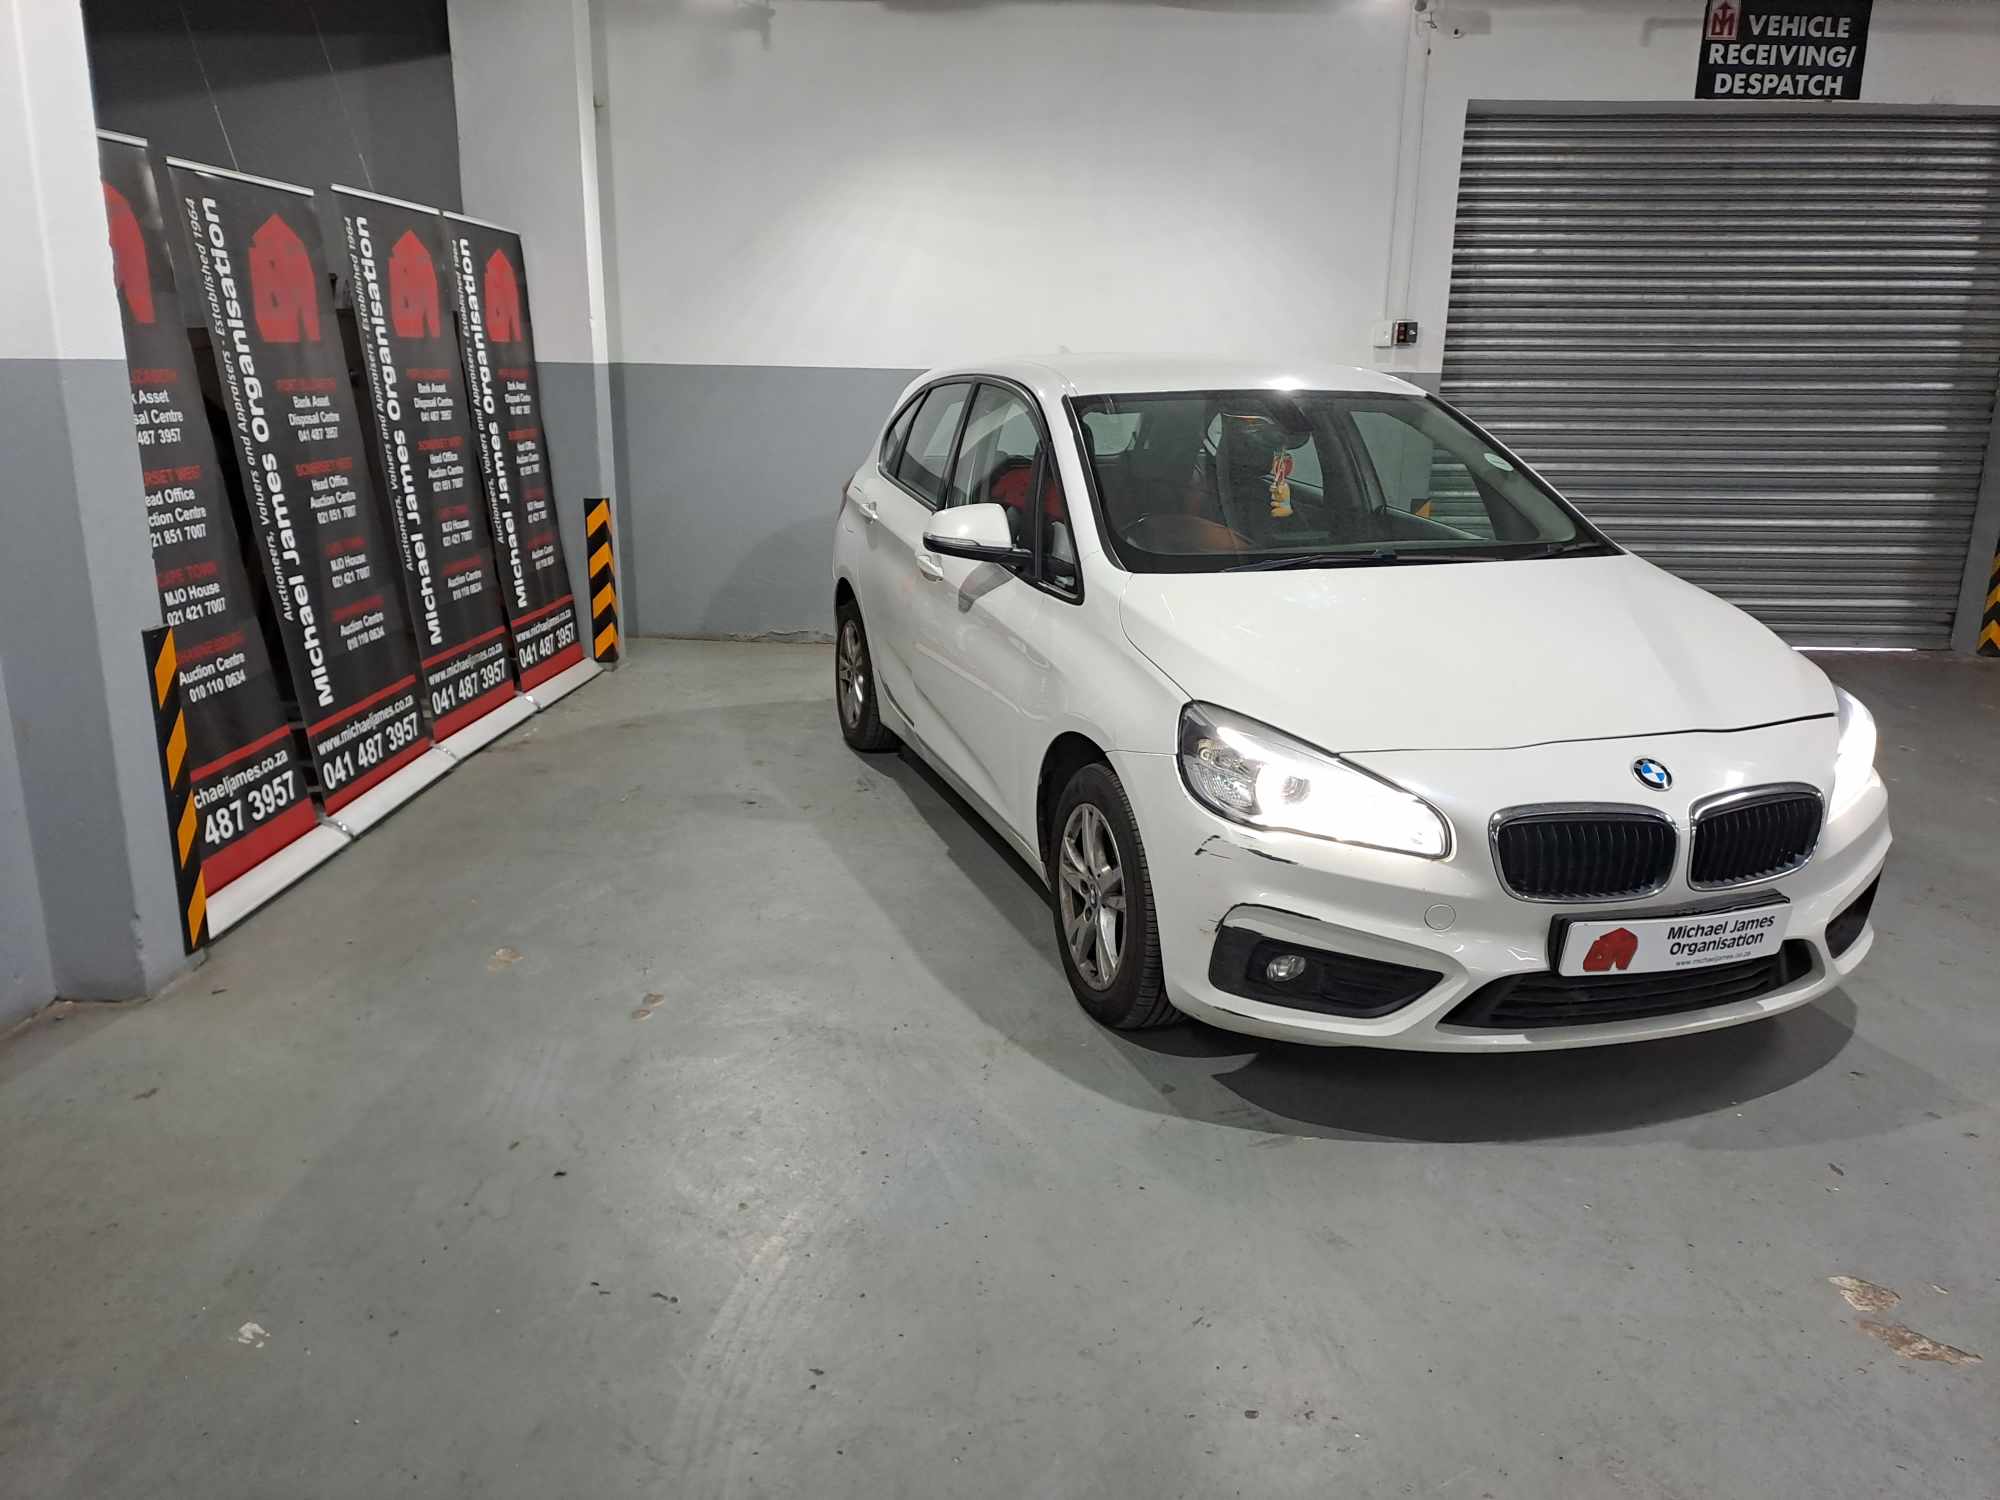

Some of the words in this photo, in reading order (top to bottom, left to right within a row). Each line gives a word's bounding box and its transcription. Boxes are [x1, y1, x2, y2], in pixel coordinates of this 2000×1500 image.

[1749, 15, 1851, 38] VEHICLE
[1708, 43, 1856, 68] RECEIVING/
[1714, 73, 1843, 96] DESPATCH
[184, 197, 203, 239] 1964
[195, 242, 226, 337] Established
[350, 253, 370, 332] Established
[202, 197, 270, 443] Organisation
[356, 216, 400, 421] Organisation
[460, 239, 495, 414] Organisation
[139, 390, 170, 404] Asset
[222, 350, 248, 433] Appraisers
[138, 430, 155, 445] 487
[158, 428, 181, 444] 3957
[150, 409, 184, 424] Centre
[378, 414, 390, 440] and
[240, 435, 256, 466] and
[385, 443, 398, 490] Valuers
[489, 422, 510, 504] James
[144, 490, 163, 507] ead
[164, 487, 195, 504] Office
[250, 469, 271, 526] Valuers
[394, 430, 420, 525] James
[148, 511, 174, 527] ction
[174, 506, 206, 522] Centre
[261, 453, 300, 566] James
[150, 532, 163, 548] 21
[163, 528, 183, 544] 851
[184, 523, 206, 540] 7007
[266, 531, 294, 622] Auctioneers,
[502, 511, 527, 608] Michael
[164, 588, 187, 606] MJO
[188, 582, 220, 599] House
[167, 609, 185, 626] 021
[186, 603, 203, 621] 421
[204, 597, 226, 616] 7007
[411, 533, 442, 645] Michael
[288, 574, 334, 707] Michael
[519, 642, 538, 668] 041
[540, 633, 554, 656] 487
[556, 622, 574, 648] 3957
[179, 661, 215, 686] Auction
[216, 652, 245, 671] Centre
[189, 686, 206, 703] 010
[206, 679, 224, 695] 110
[432, 684, 455, 714] 041
[459, 672, 478, 700] 487
[480, 658, 504, 688] 3957
[317, 695, 414, 756] www.michaeljames.co.za
[323, 751, 355, 789] 041
[358, 733, 383, 768] 487
[386, 712, 418, 751] 3957
[194, 750, 288, 809] chaeljames.co.za
[205, 799, 244, 845] 487
[247, 770, 295, 821] 3957
[1667, 921, 1728, 939] Michael
[1730, 916, 1775, 933] James
[1670, 932, 1764, 956] Organisation
